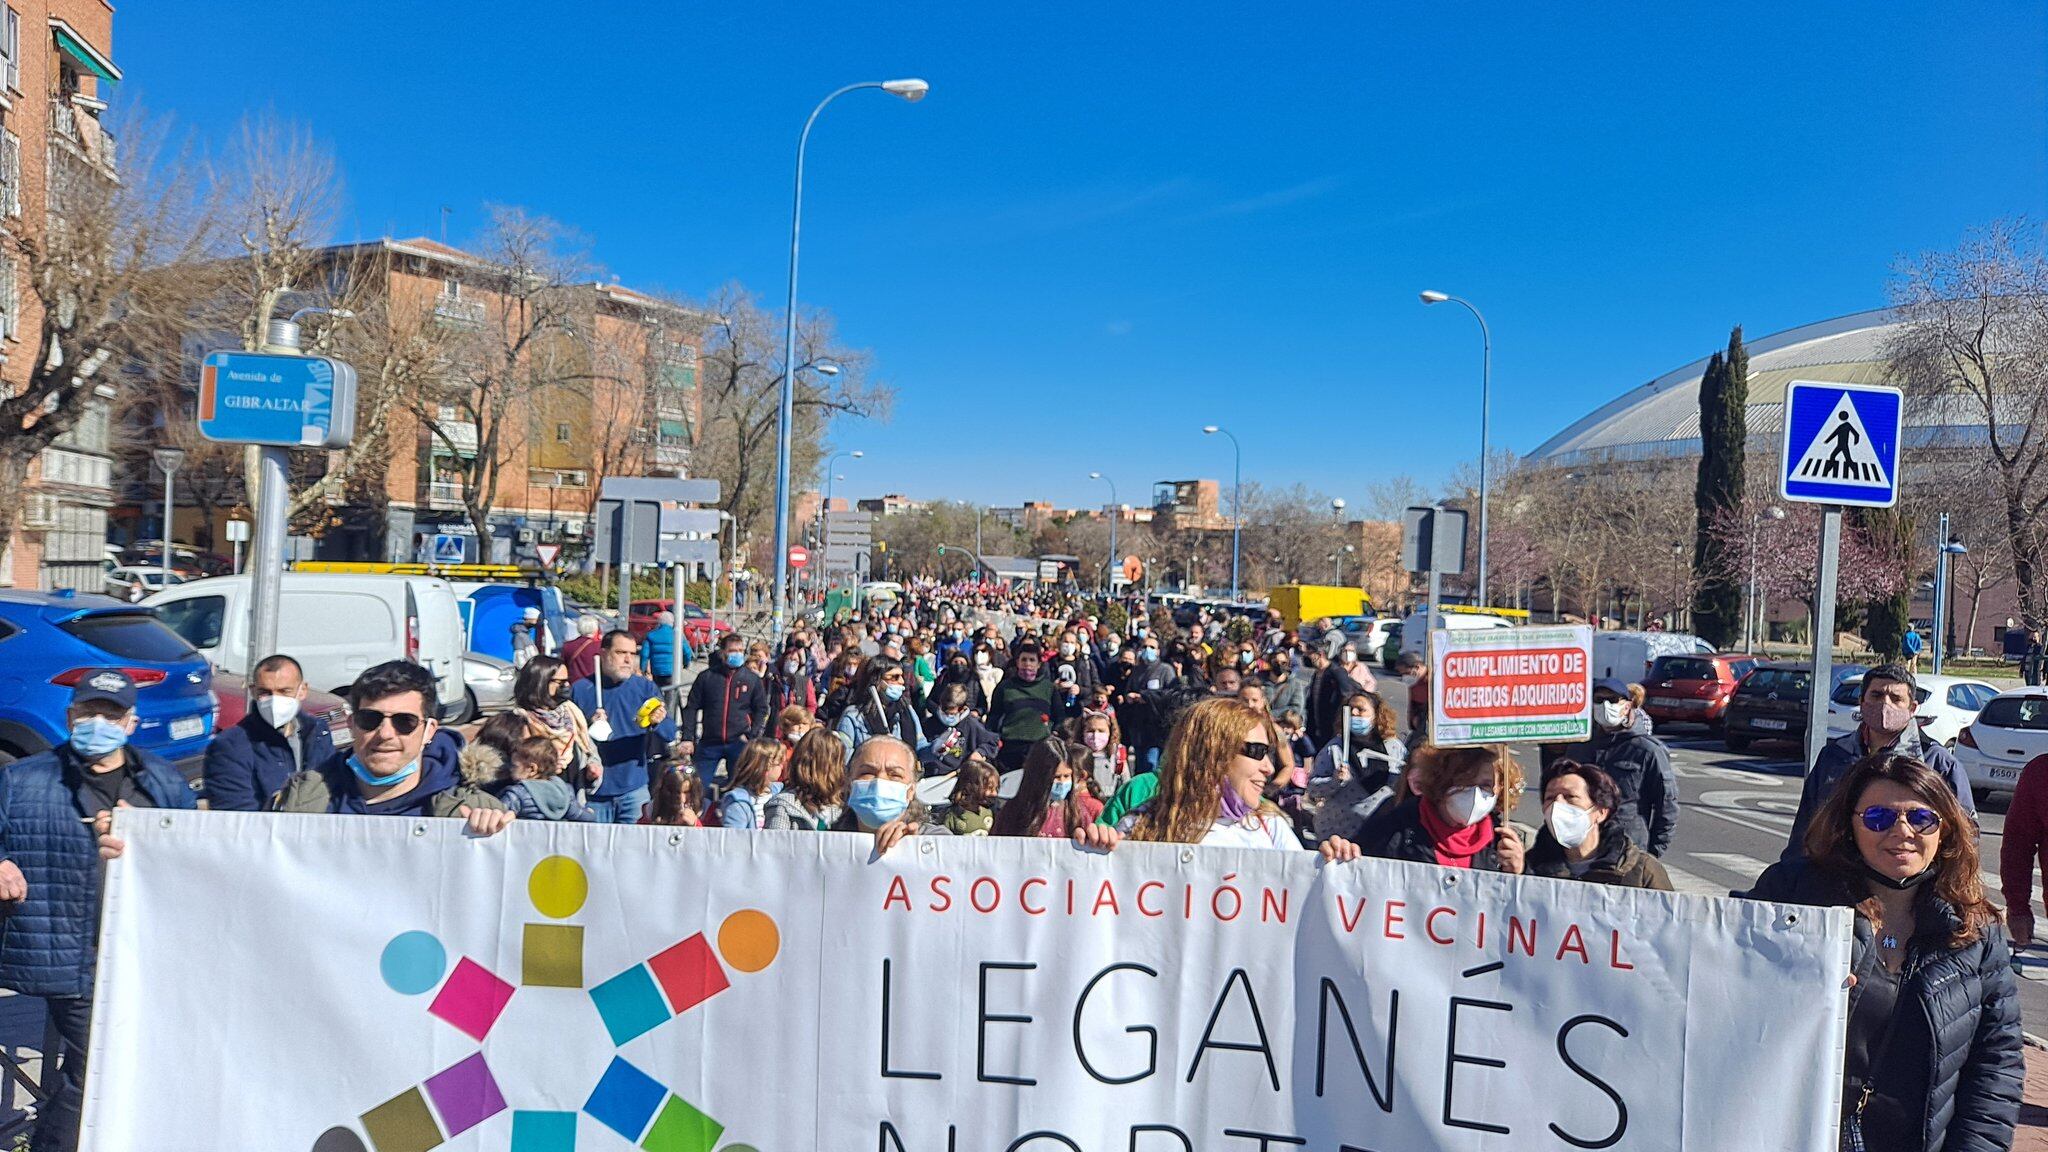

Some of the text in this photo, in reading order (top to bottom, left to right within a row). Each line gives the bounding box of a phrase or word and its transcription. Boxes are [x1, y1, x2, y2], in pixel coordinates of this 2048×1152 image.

[227, 370, 282, 383] Avenida de
[1445, 653, 1584, 678] CUMPLIMIENTO DE
[1445, 682, 1585, 709] ACUERDOS ADQUIRIDOS
[882, 872, 1634, 970] ASOCIACIÓN VECINAL
[880, 957, 1630, 1149] LEGANÉS
